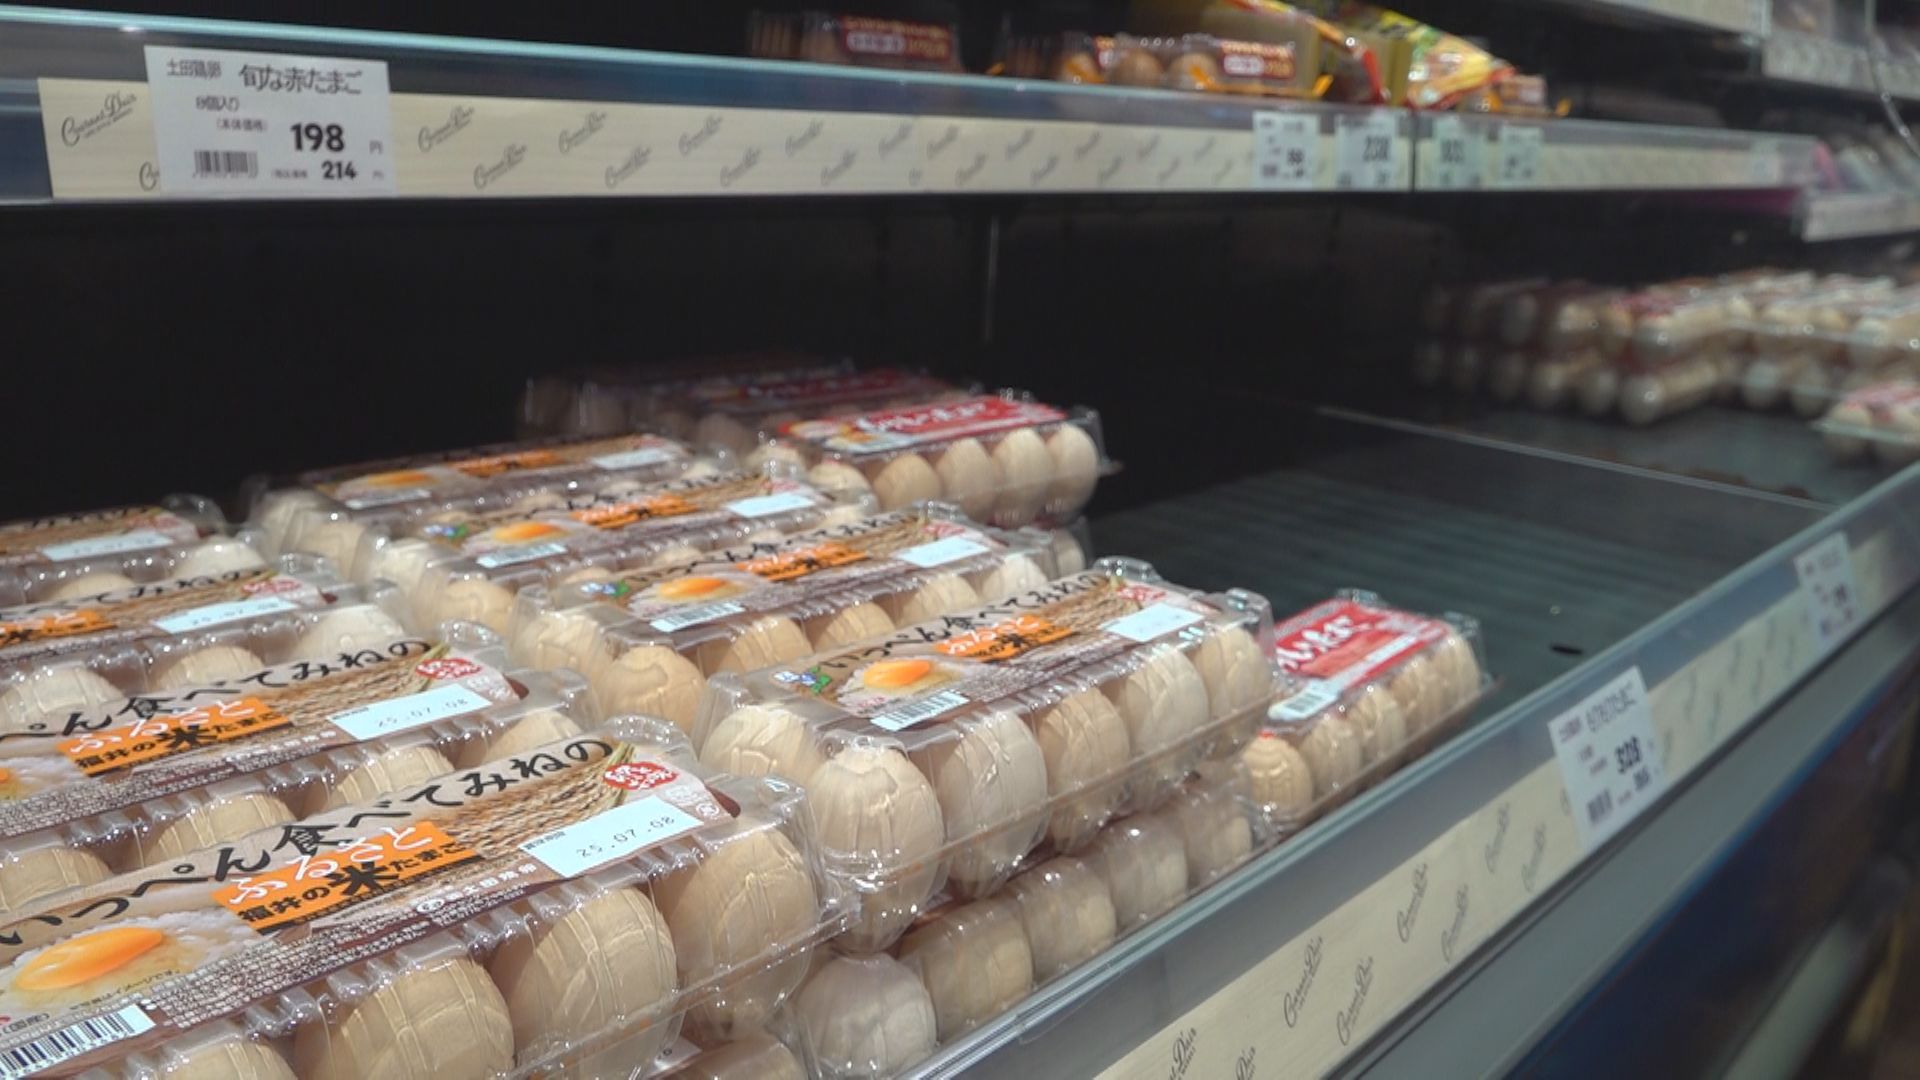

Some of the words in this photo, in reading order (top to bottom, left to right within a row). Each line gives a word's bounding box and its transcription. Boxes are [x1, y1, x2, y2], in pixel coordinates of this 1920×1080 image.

[239, 63, 364, 96] 旬な赤たまご
[290, 122, 346, 153] 198
[321, 160, 358, 181] 214
